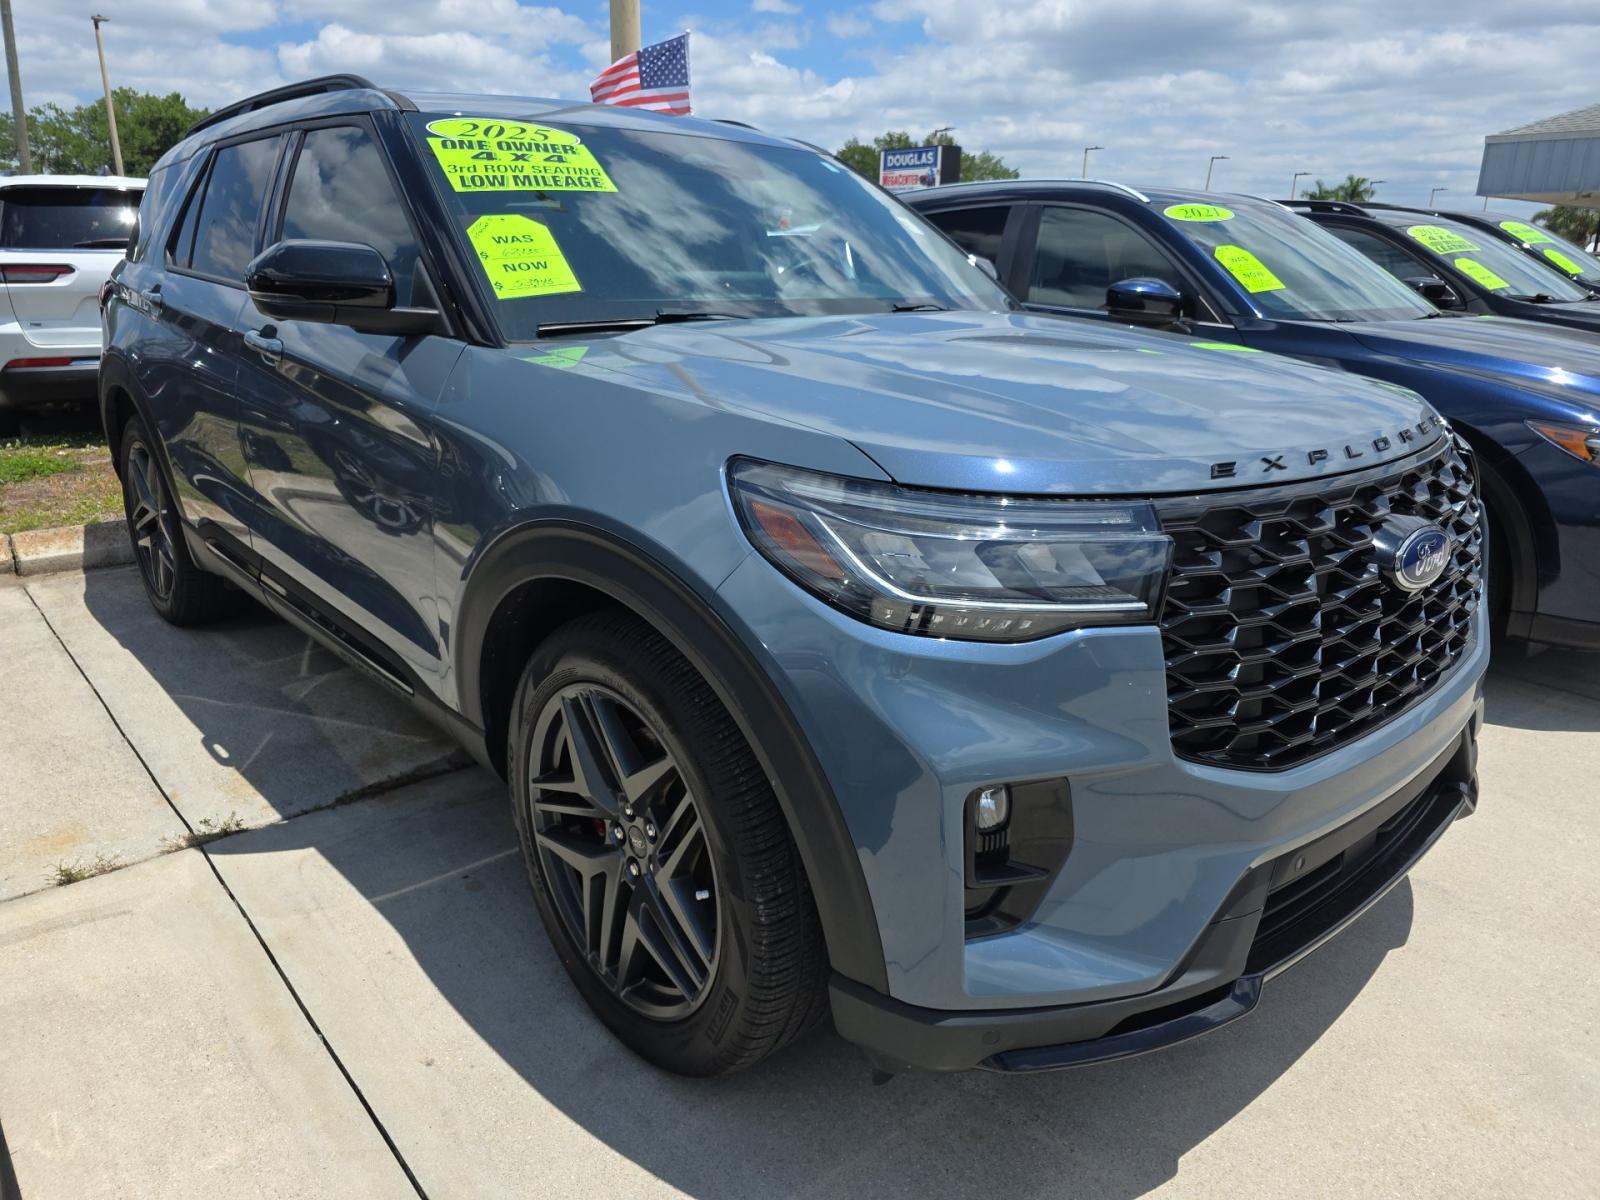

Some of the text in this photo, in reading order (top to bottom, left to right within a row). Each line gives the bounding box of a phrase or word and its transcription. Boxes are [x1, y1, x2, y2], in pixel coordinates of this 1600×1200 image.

[458, 122, 552, 142] 2025
[441, 139, 578, 155] ONE OWNER
[887, 151, 934, 168] DOUGLAS
[447, 164, 602, 177] 3rd ROW SEATING
[459, 174, 604, 188] LOW MILEAGE
[491, 234, 534, 244] WAS
[502, 261, 548, 272] NOW
[1415, 537, 1446, 577] Ford
